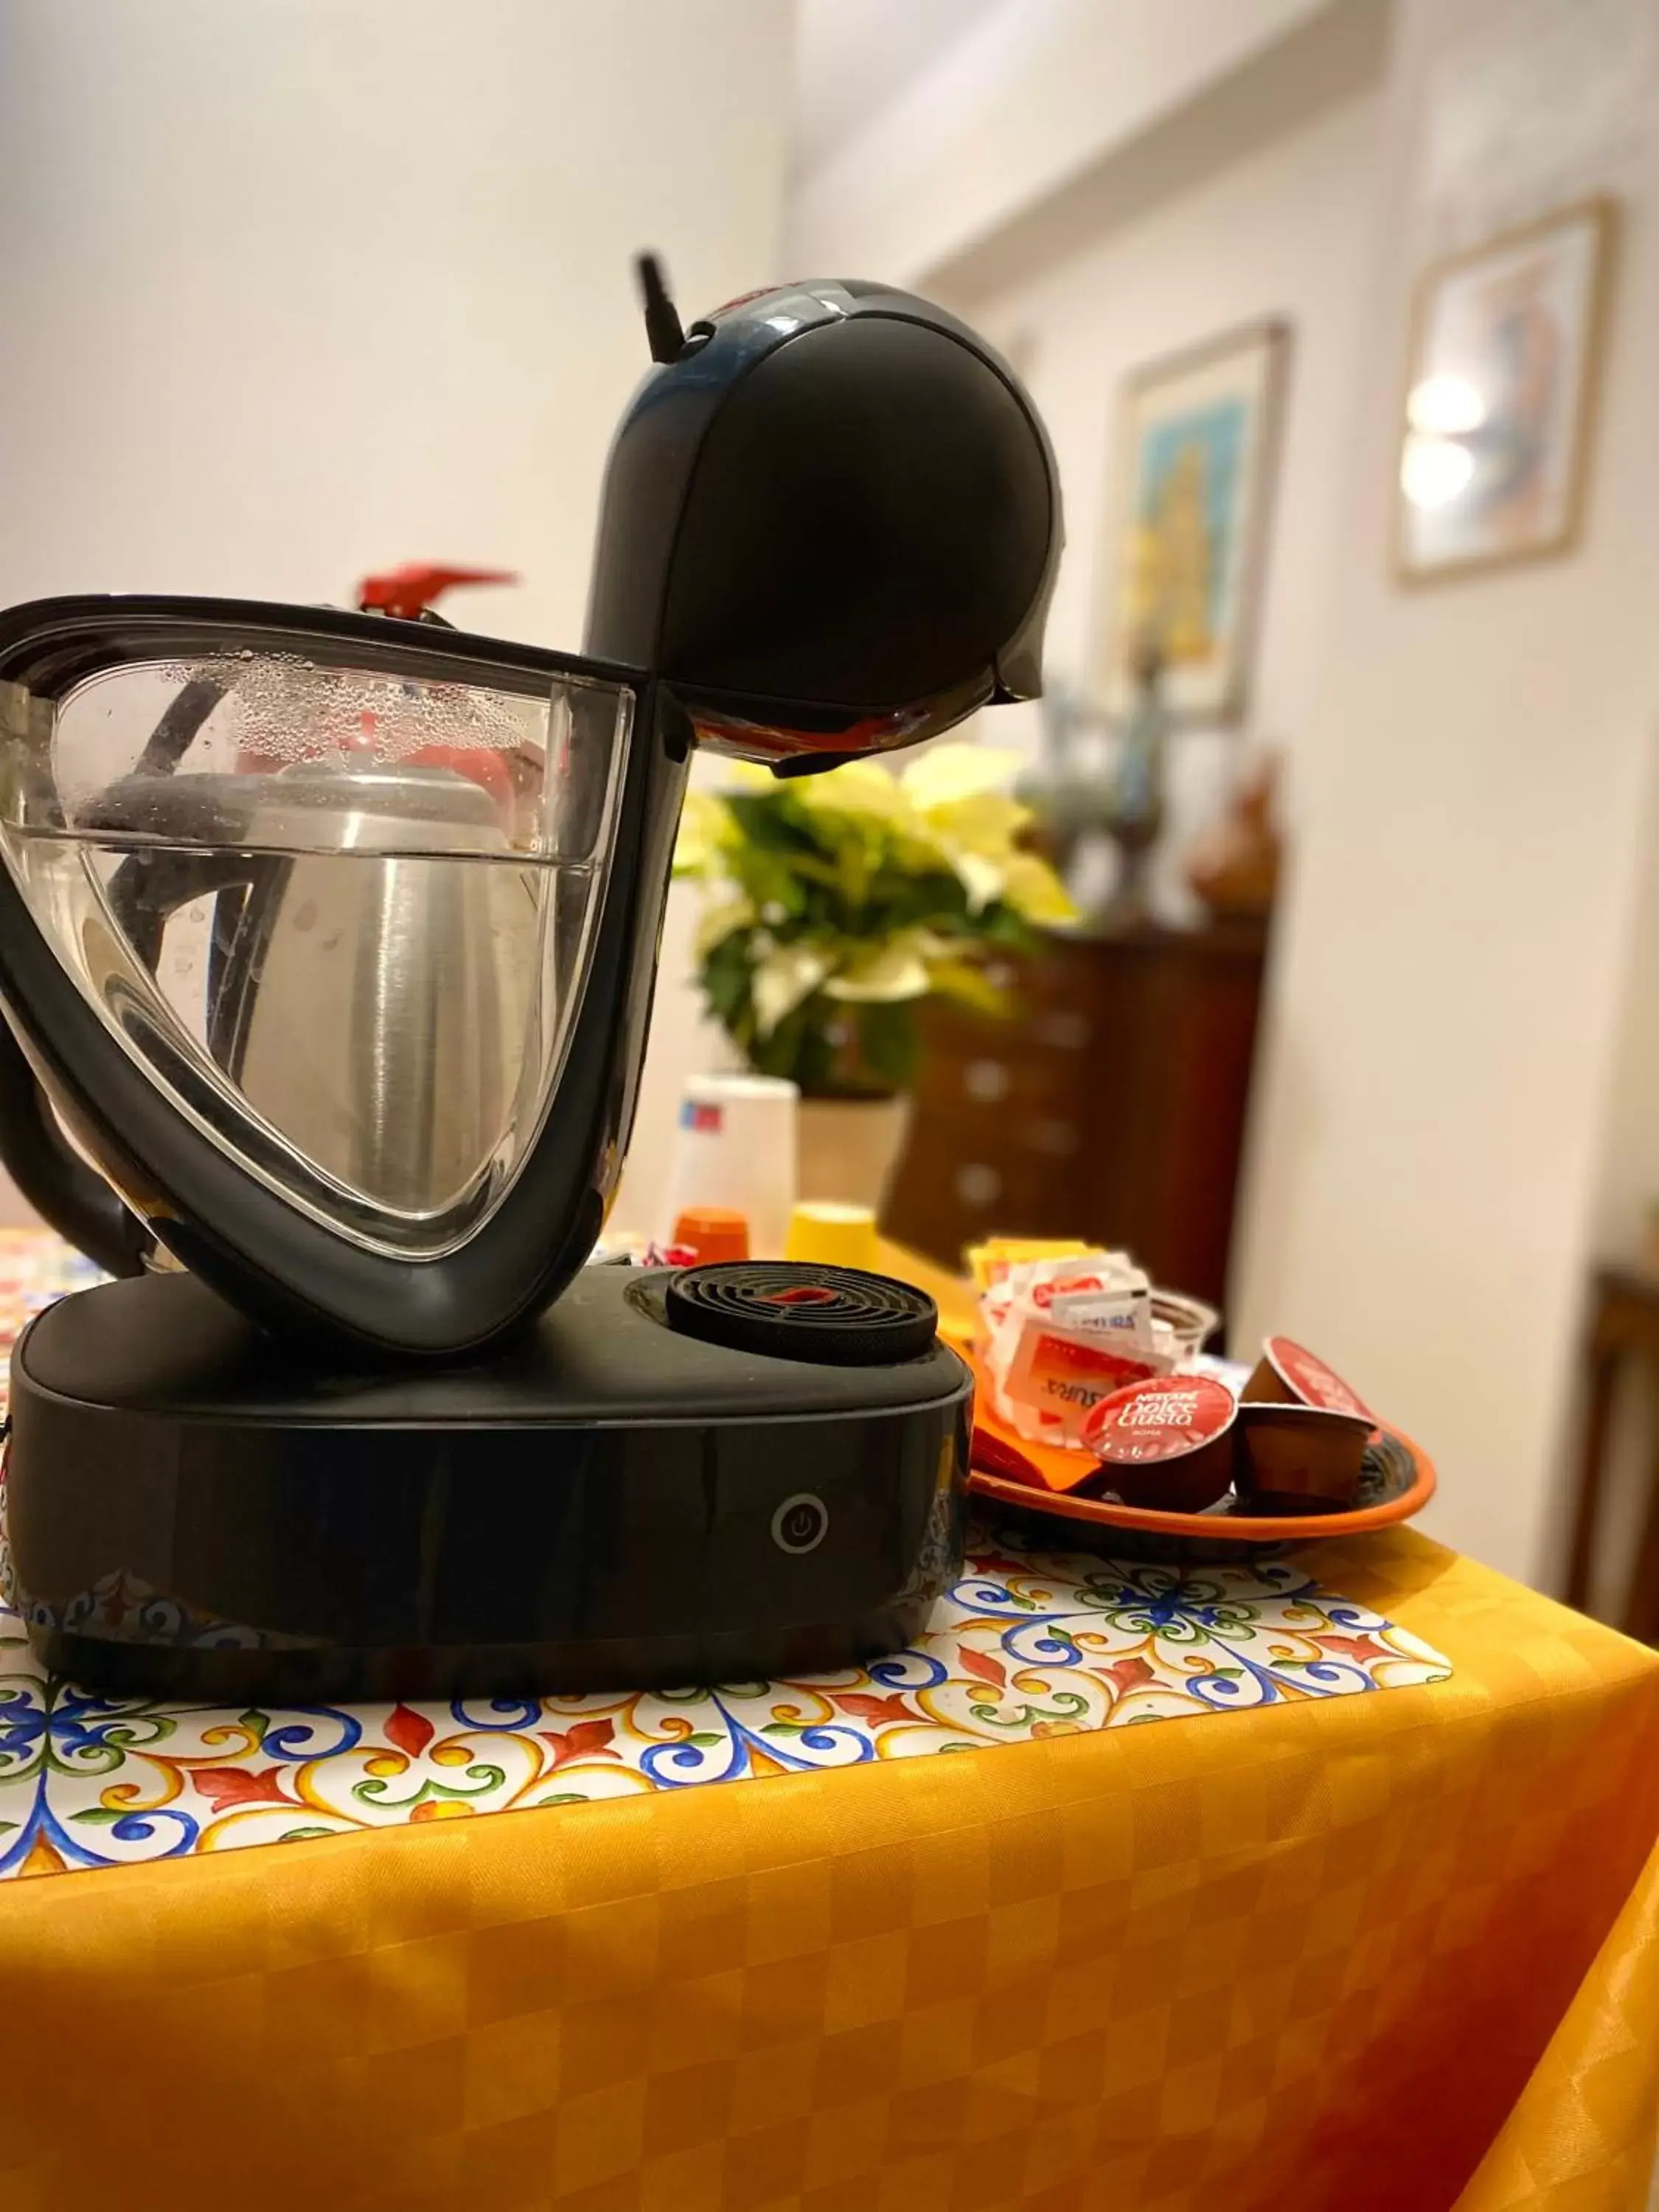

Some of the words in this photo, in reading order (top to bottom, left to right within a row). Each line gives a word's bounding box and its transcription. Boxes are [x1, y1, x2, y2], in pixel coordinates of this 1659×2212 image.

[1046, 1377, 1100, 1409] SURA
[1122, 1400, 1198, 1415] Dolce
[1118, 1412, 1192, 1427] Gusto
